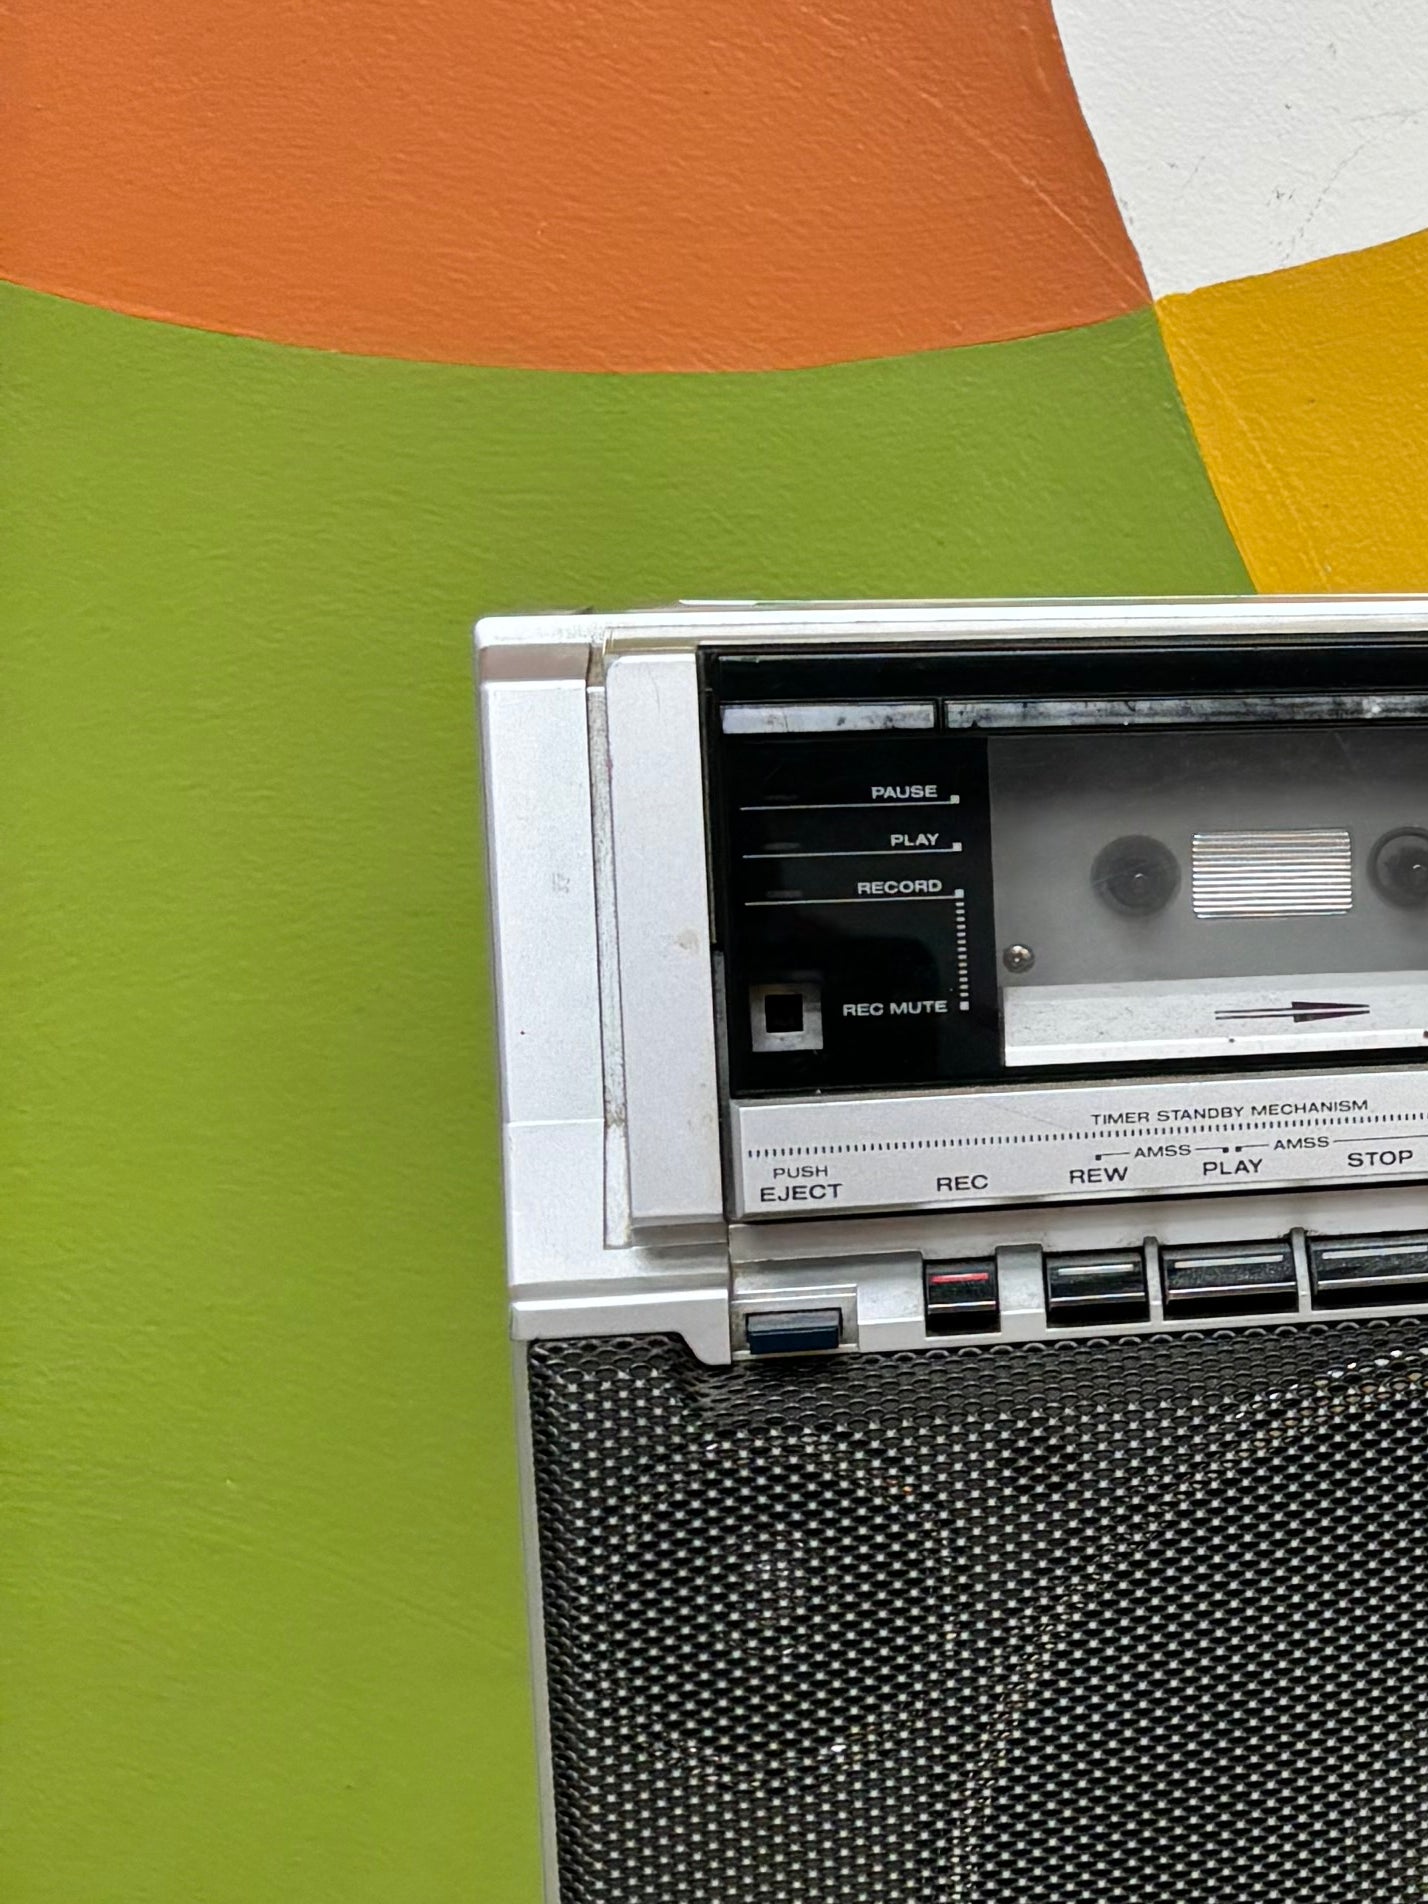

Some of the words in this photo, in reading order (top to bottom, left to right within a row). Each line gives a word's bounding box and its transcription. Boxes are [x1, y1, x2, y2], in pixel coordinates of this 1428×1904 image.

[871, 785, 937, 799] PAUSE
[890, 834, 939, 847] PLAY
[857, 880, 942, 895] RECORD
[843, 1003, 886, 1016] REC
[890, 1001, 947, 1015] MUTE
[1091, 1111, 1150, 1125] TIMER
[1156, 1105, 1245, 1123] STANDBY
[1251, 1099, 1368, 1117] MECHANISM
[1134, 1144, 1191, 1159] AMSS
[1273, 1136, 1330, 1152] AMSS
[1347, 1149, 1413, 1169] STOP
[773, 1165, 828, 1178] PUSH
[1069, 1167, 1128, 1184] REW
[1202, 1158, 1262, 1177] PLAY
[937, 1174, 989, 1192] REC
[760, 1183, 843, 1203] EJECT
